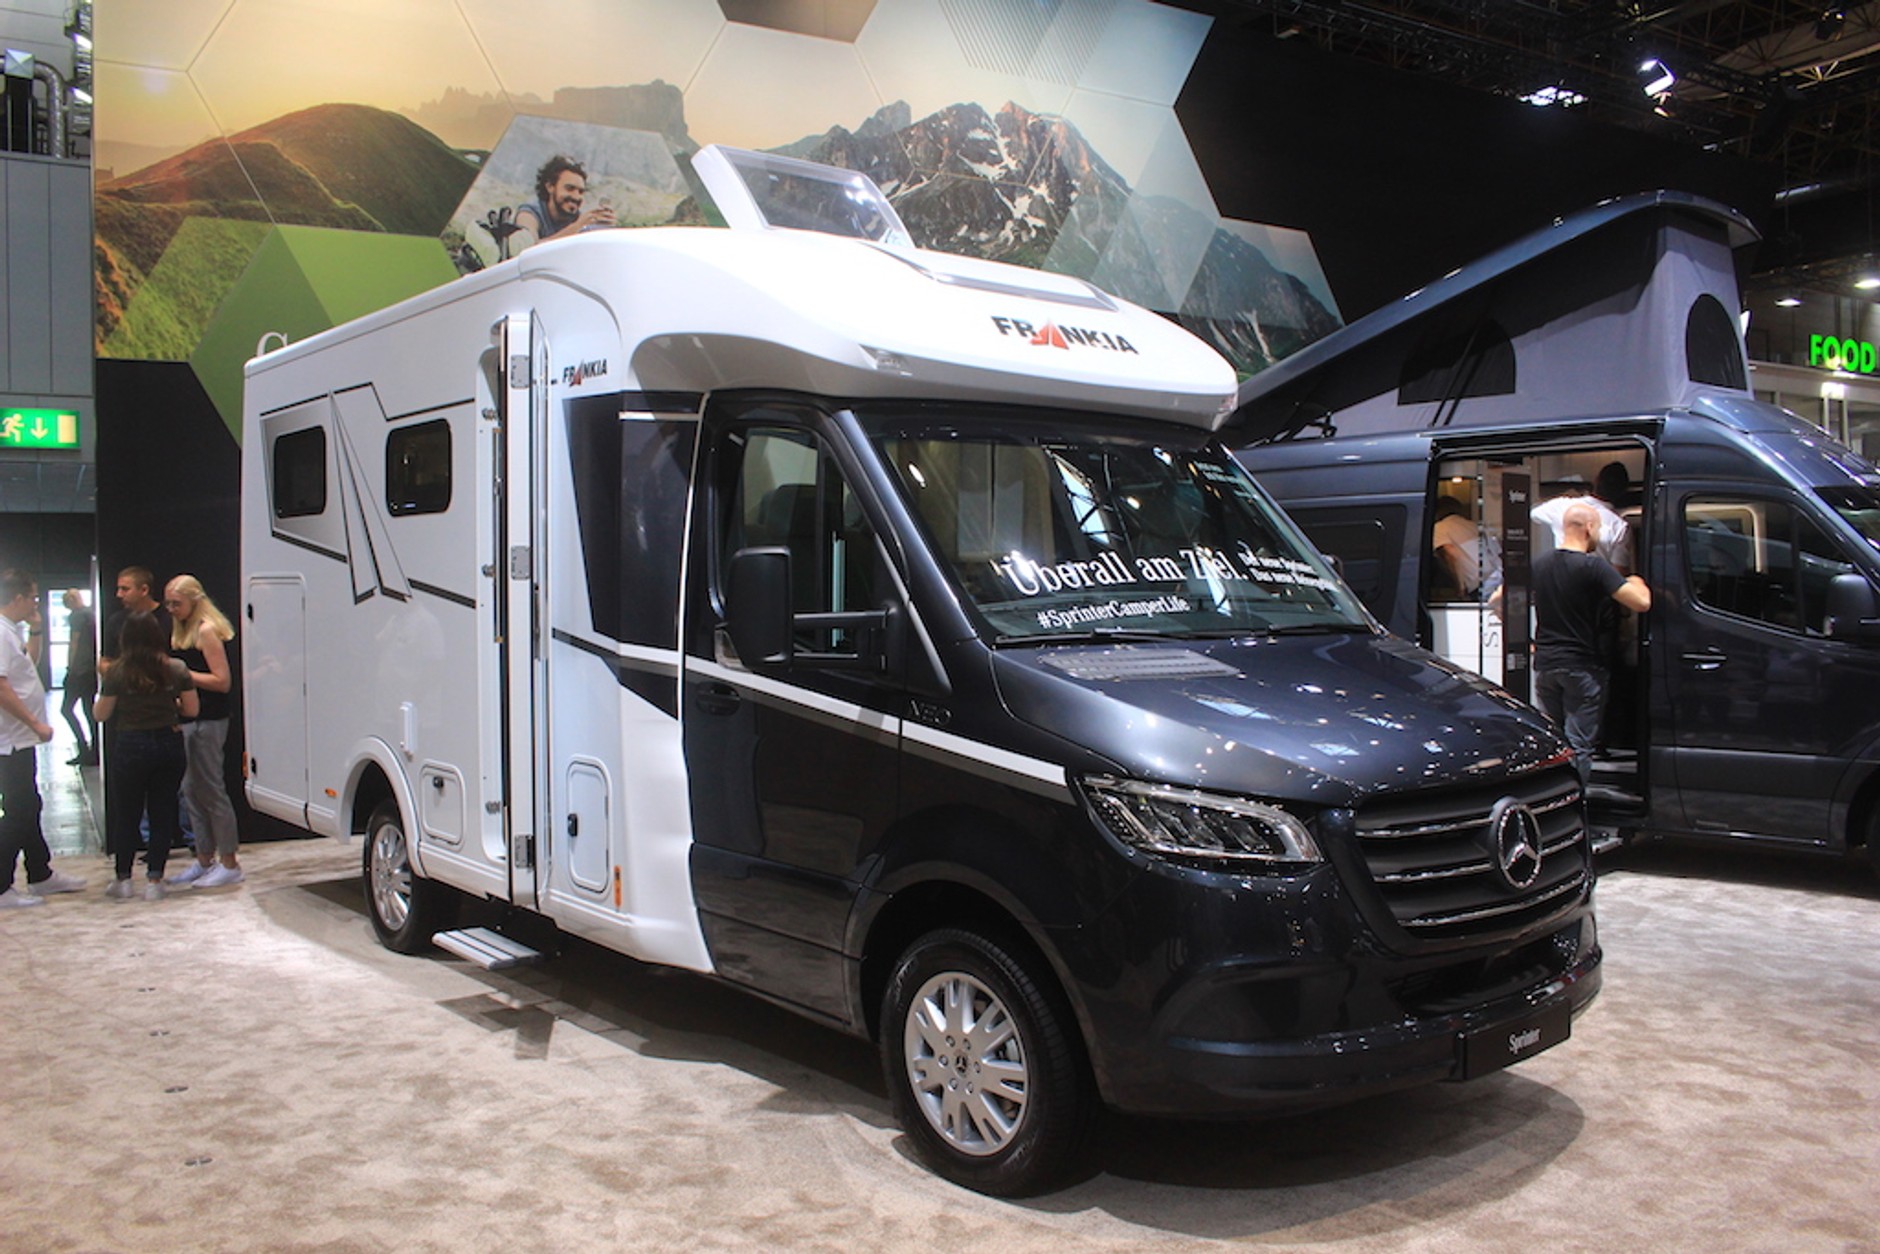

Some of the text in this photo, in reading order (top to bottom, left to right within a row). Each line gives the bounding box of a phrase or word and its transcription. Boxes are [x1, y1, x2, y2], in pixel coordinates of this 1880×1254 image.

[991, 315, 1139, 355] FRANKIA
[1810, 333, 1876, 373] FOOD
[562, 358, 608, 388] FRANKIA
[1000, 550, 1137, 597] Überall
[1135, 556, 1188, 582] am
[1037, 595, 1191, 630] #SprinterCamperLife
